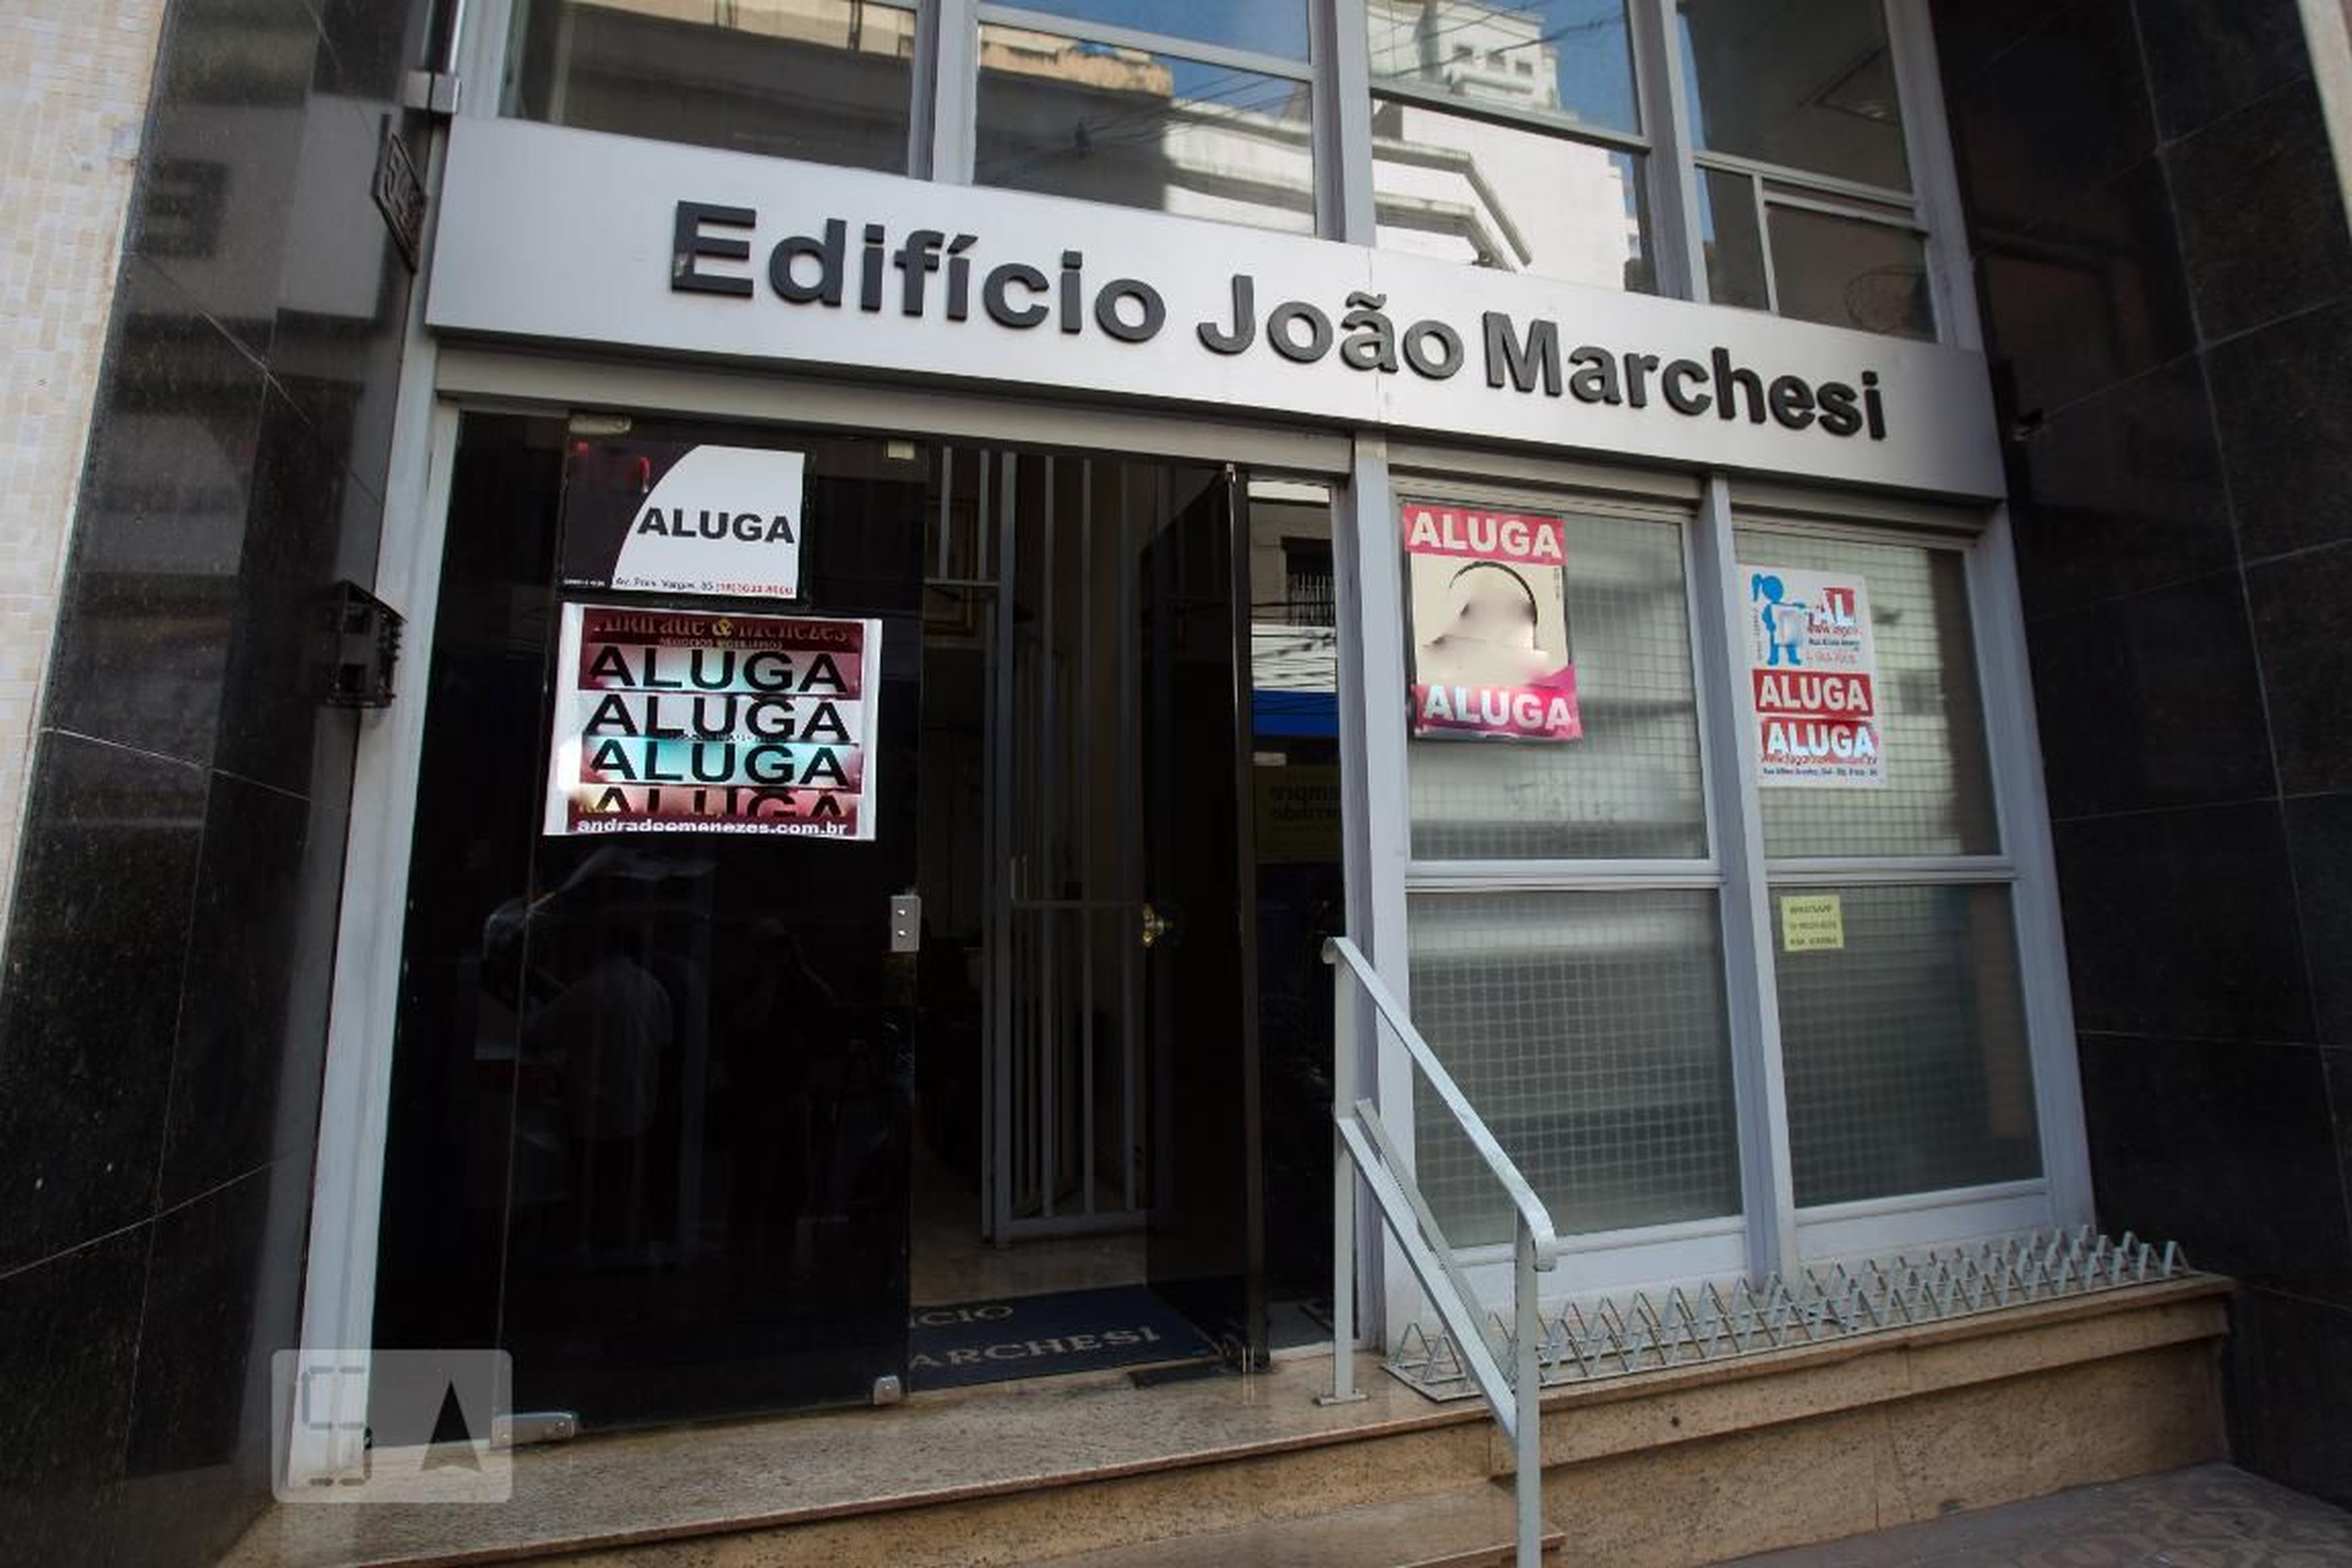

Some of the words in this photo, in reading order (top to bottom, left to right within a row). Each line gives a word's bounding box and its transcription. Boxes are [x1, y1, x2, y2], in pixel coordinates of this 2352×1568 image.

[671, 200, 1167, 343] Edifício
[1197, 274, 1465, 379] João
[1482, 311, 1888, 442] Marchesi
[636, 507, 795, 544] ALUGA
[1409, 511, 1563, 559] ALUGA
[589, 646, 848, 693] ALUGA
[1758, 674, 1869, 712] ALUGA
[585, 693, 851, 741] ALUGA
[1422, 684, 1572, 731] ALUGA
[590, 739, 850, 786] ALUGA
[1766, 722, 1877, 759] ALUGA
